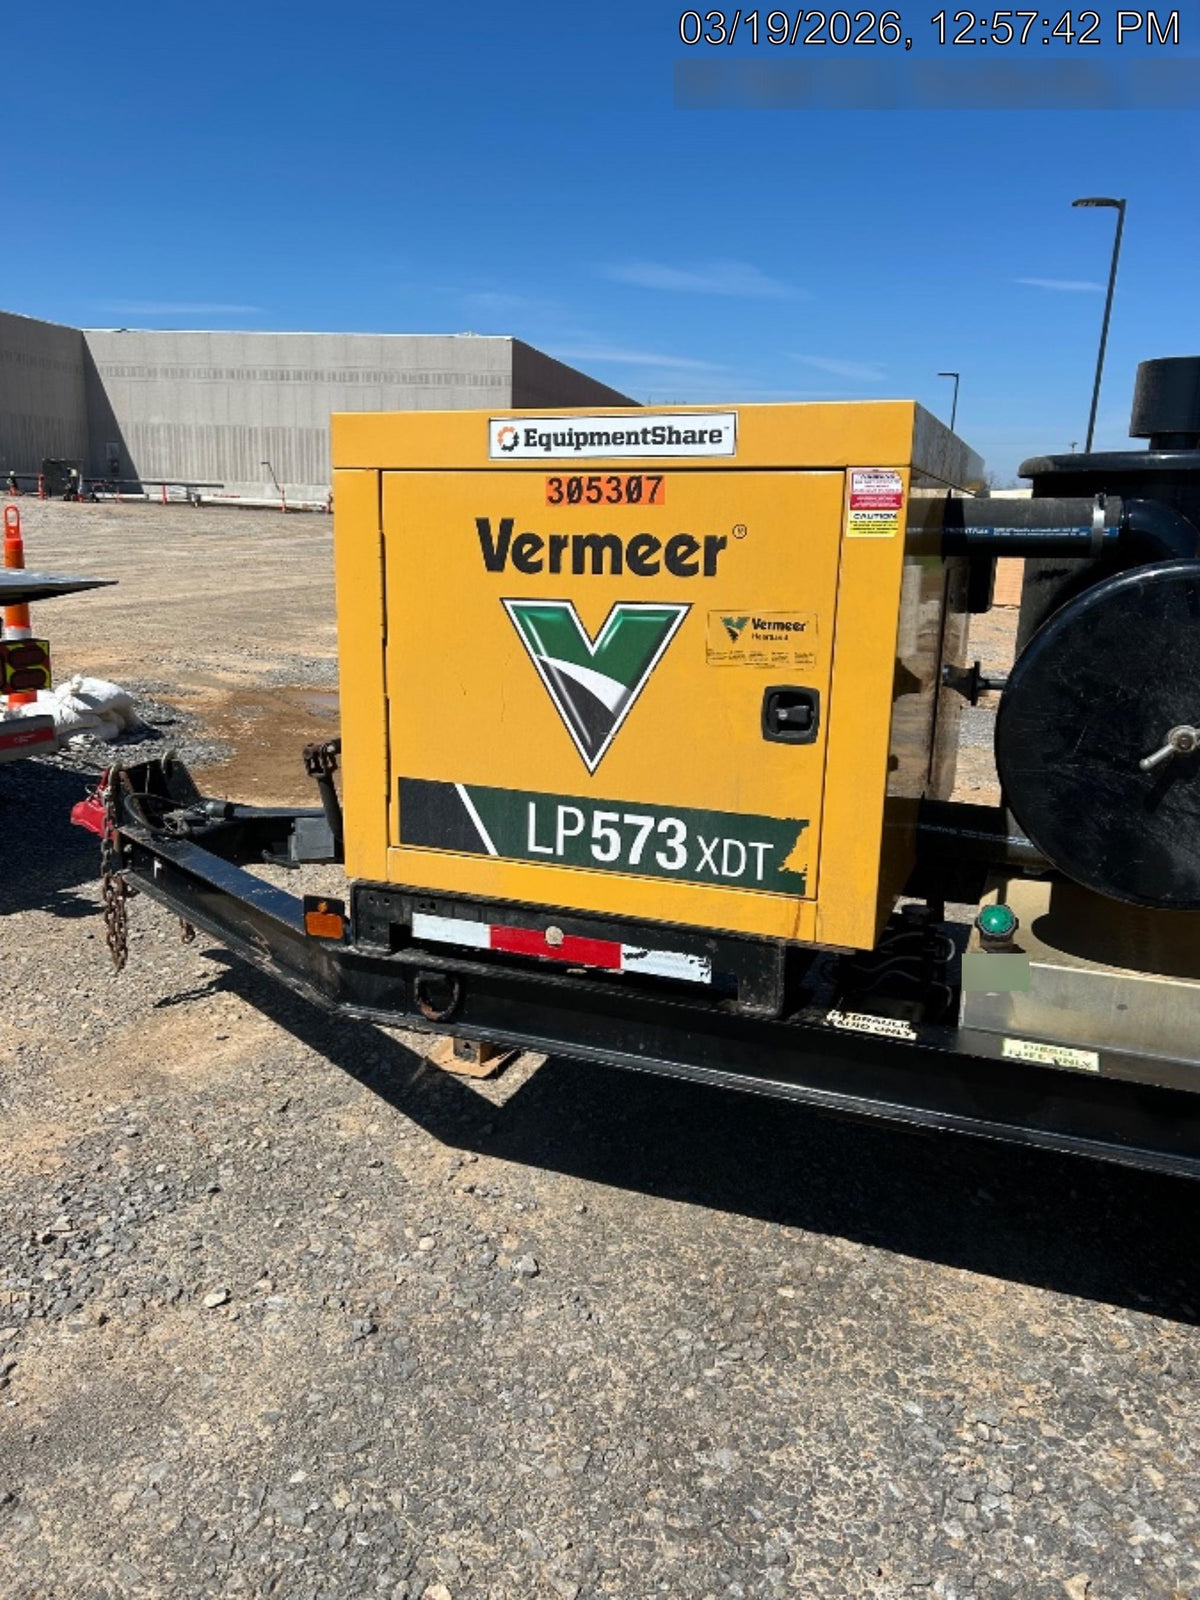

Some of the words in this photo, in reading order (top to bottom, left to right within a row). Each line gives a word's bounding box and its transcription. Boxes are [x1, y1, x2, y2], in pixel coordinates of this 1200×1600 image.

[523, 425, 723, 451] EquipmentShare
[547, 476, 664, 504] 305307
[751, 618, 806, 632] Vermeer
